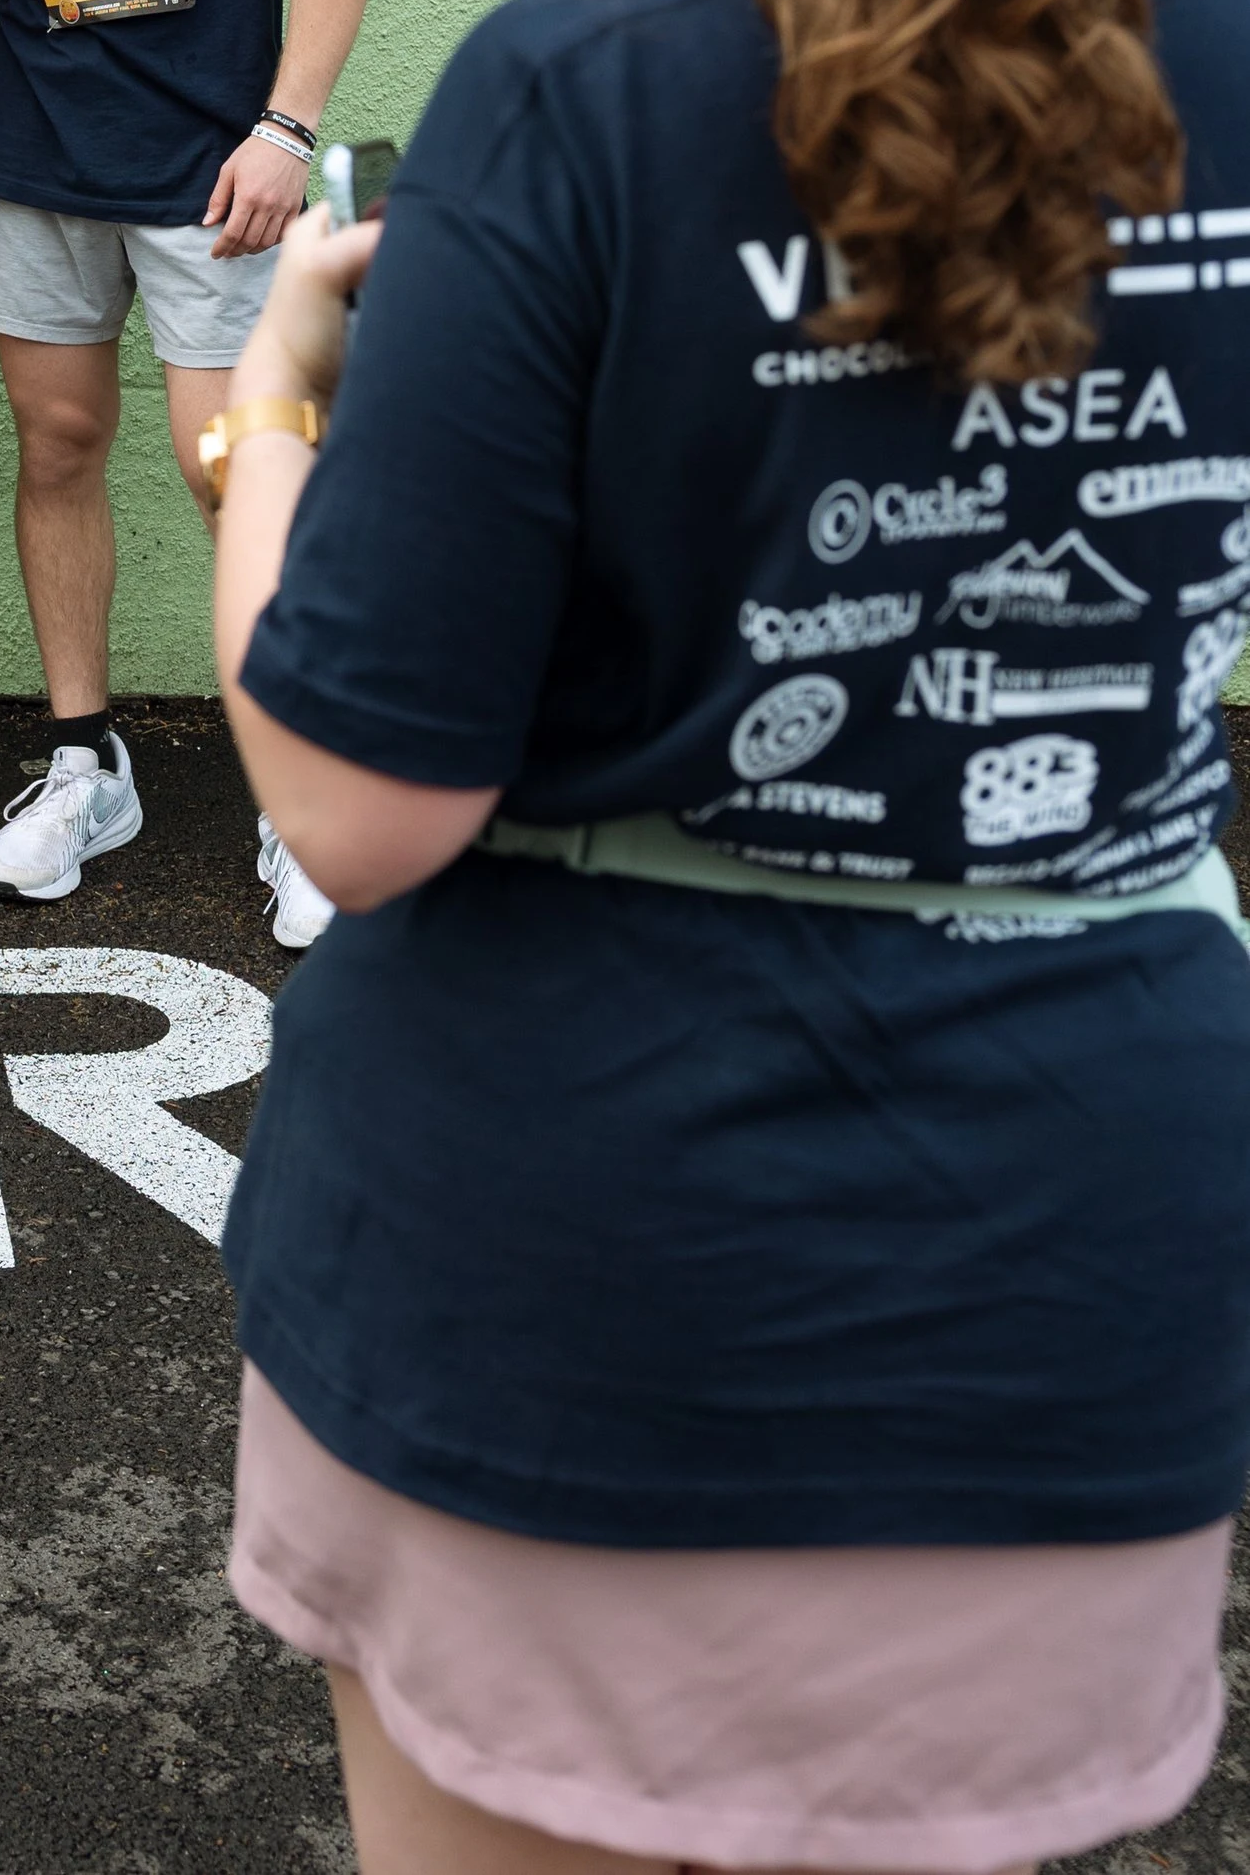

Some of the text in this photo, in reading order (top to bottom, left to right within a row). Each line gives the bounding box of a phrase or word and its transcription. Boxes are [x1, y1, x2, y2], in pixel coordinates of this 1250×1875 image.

[950, 366, 1188, 451] ASEA
[892, 647, 1000, 726] NH
[756, 781, 887, 824] STEVENS
[838, 852, 915, 881] TRUST
